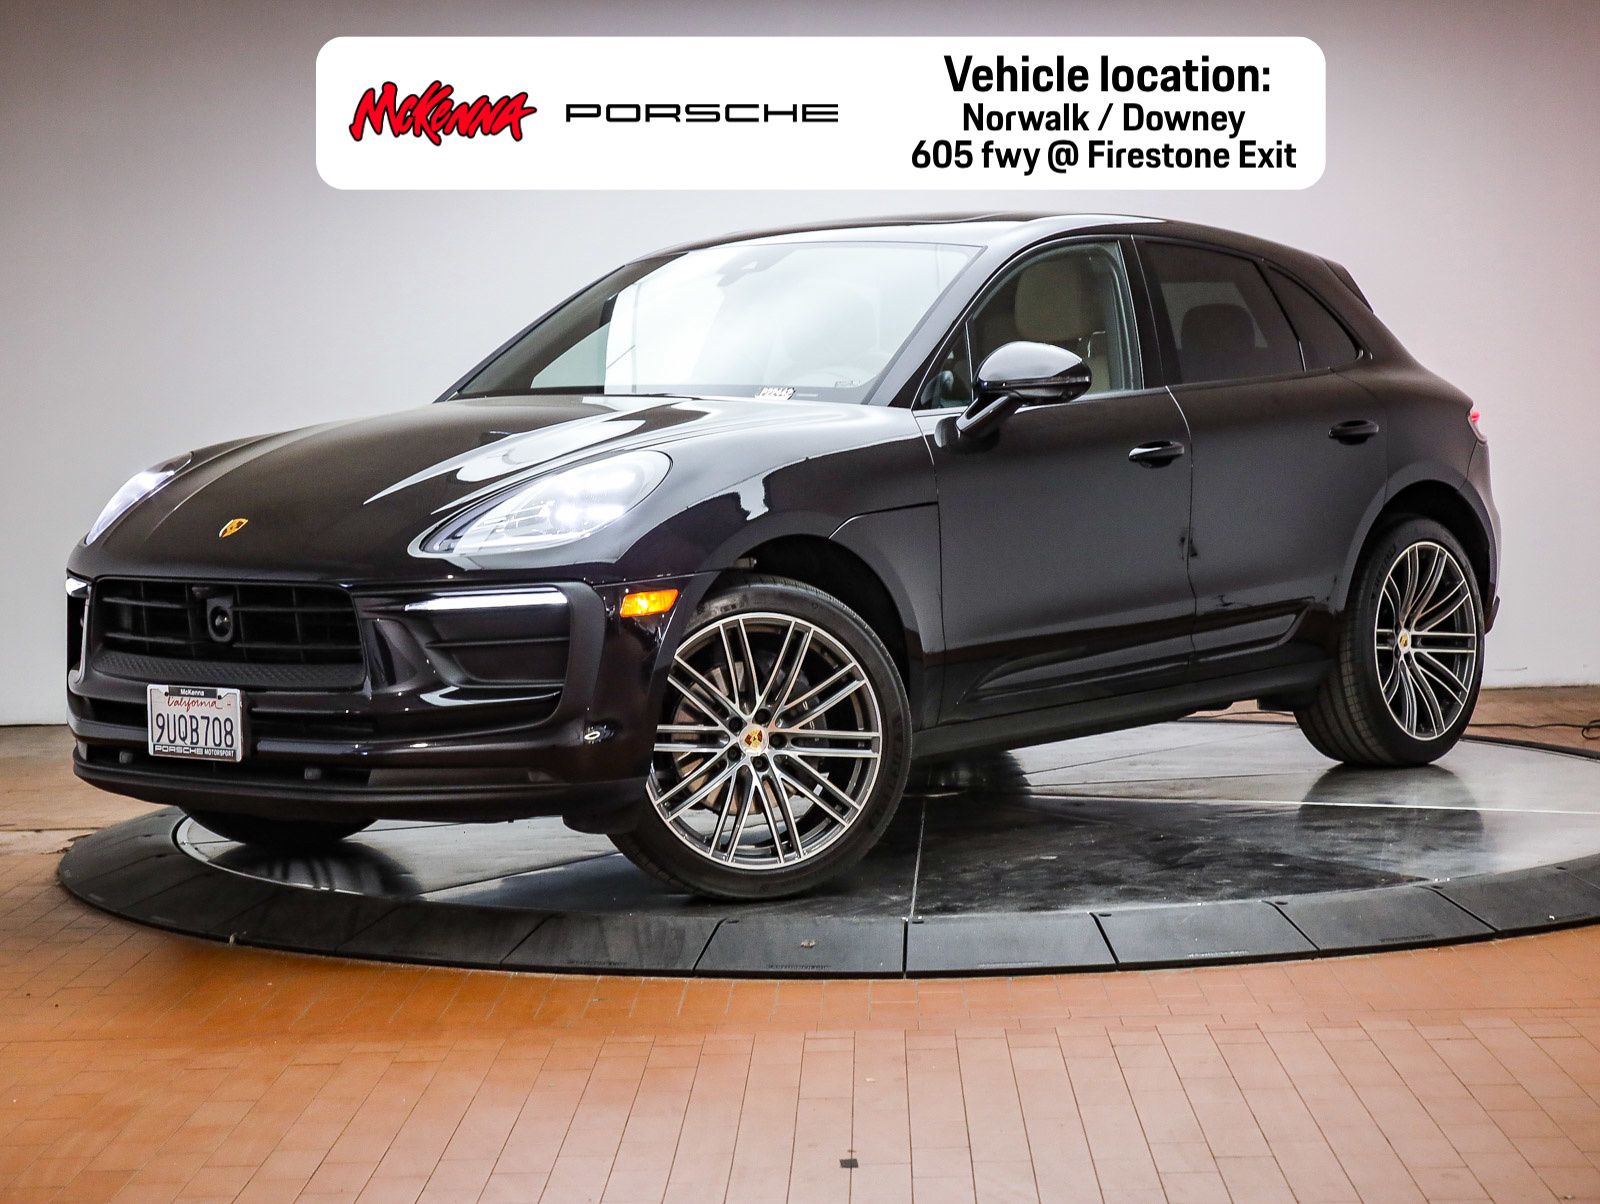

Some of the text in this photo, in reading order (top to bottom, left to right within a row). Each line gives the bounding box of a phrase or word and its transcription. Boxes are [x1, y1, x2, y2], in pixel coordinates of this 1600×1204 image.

[181, 689, 205, 697] McKenna
[168, 697, 223, 712] California
[156, 713, 234, 747] 9UQB708
[155, 746, 234, 757] PORSCHE MOTORSPORT
